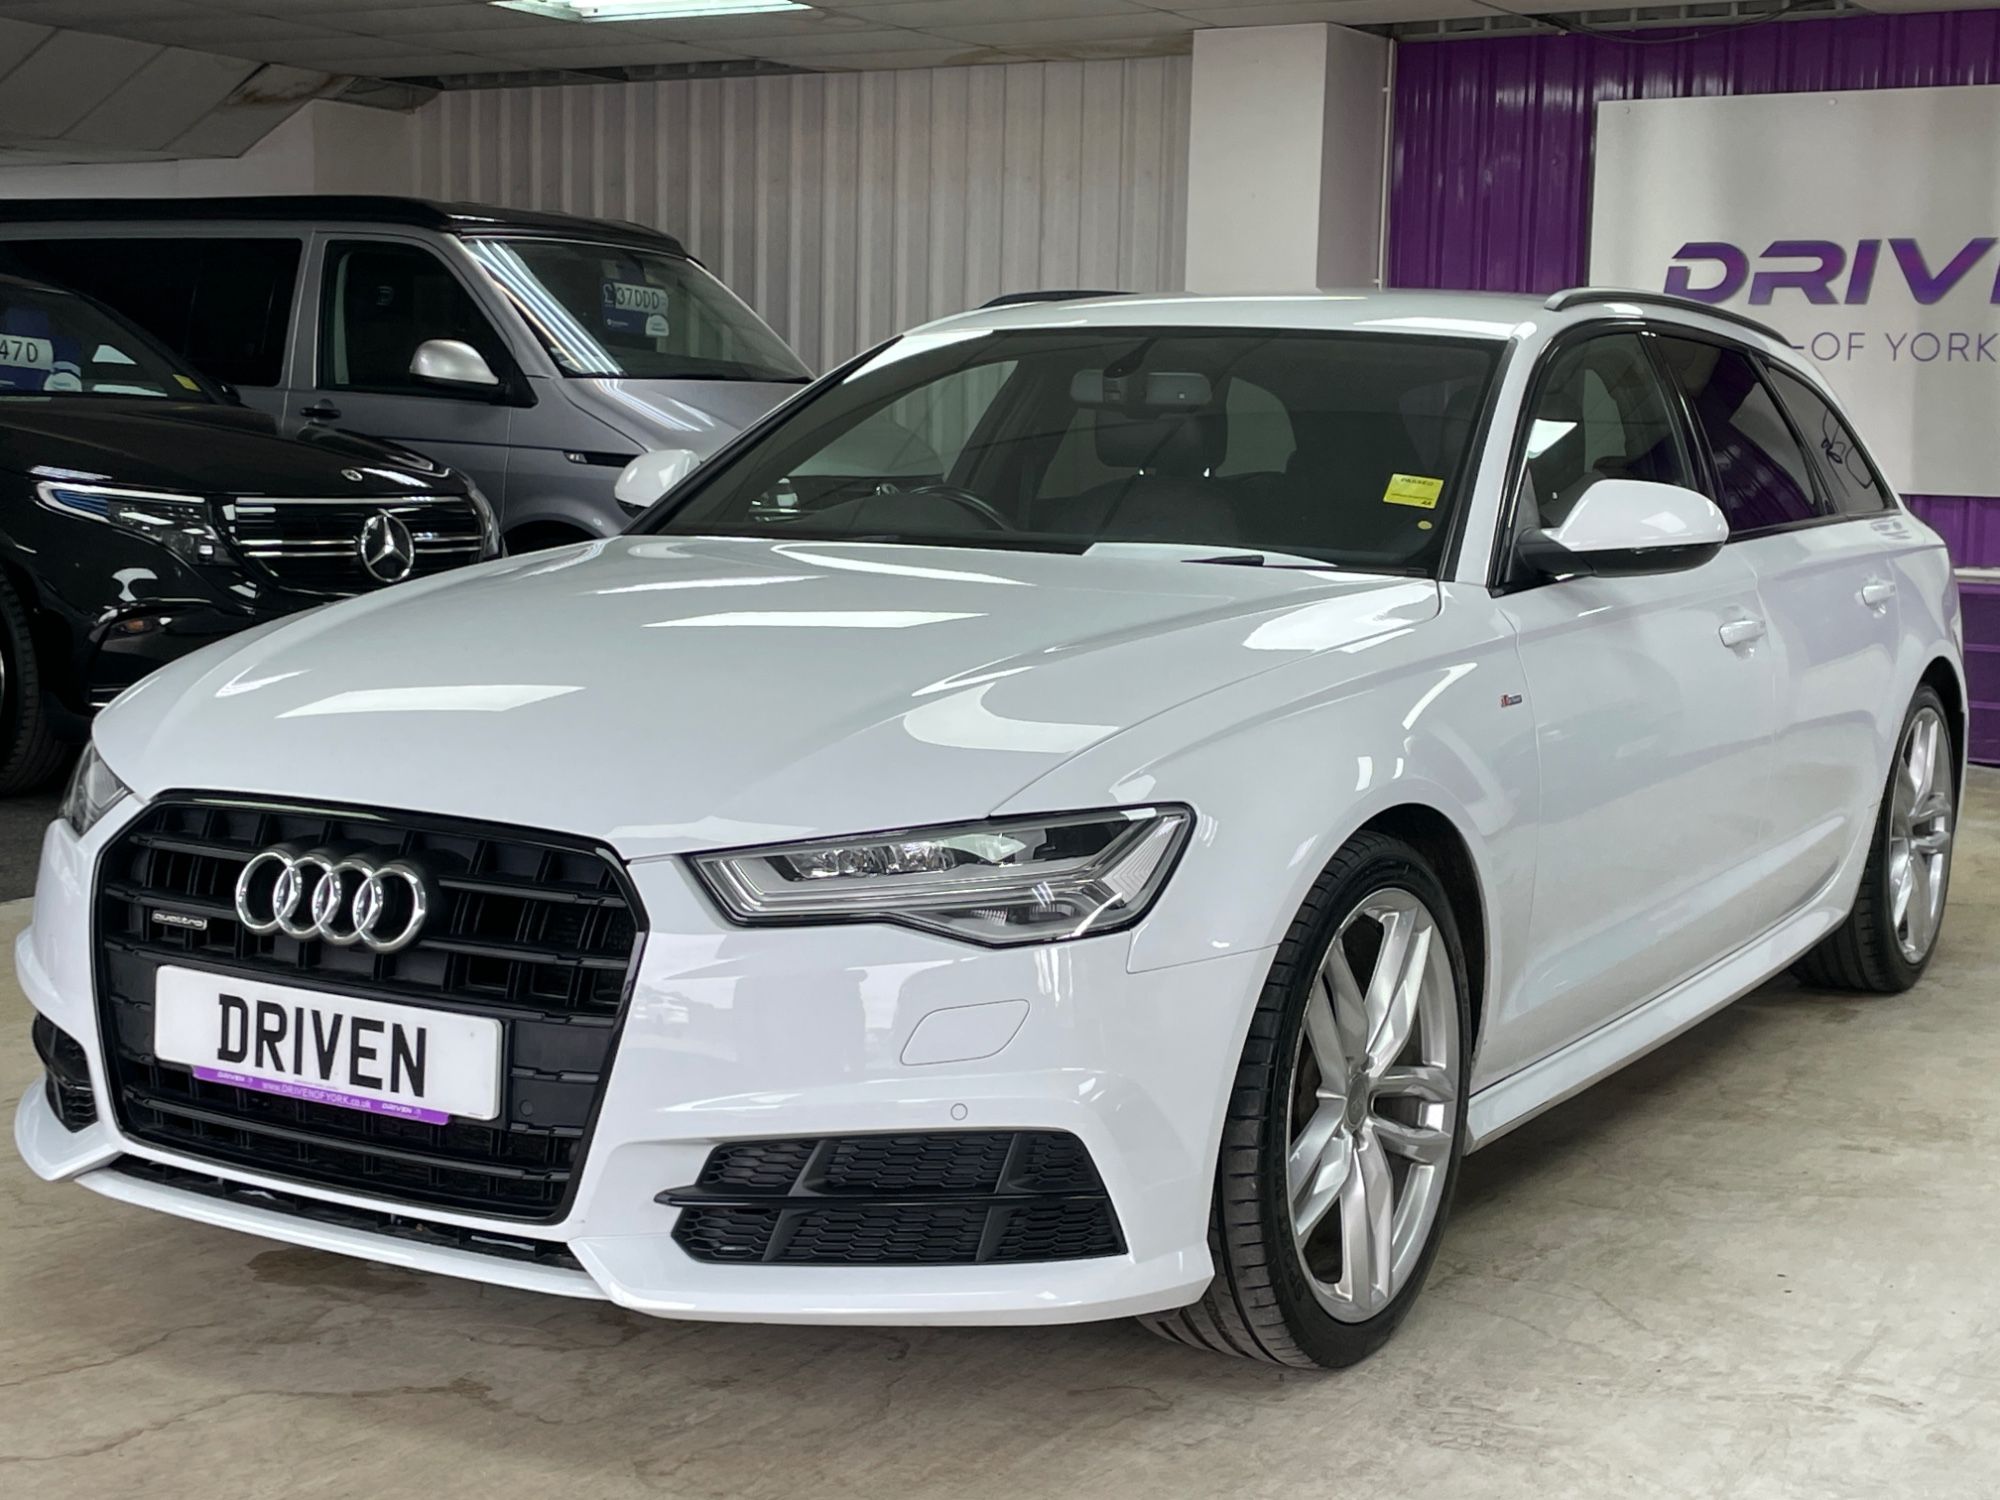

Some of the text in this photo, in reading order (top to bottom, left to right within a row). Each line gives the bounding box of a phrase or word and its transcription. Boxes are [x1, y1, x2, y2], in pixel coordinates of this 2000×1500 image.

[1811, 332, 1999, 362] OF YORK
[217, 993, 427, 1098] DRIVEN
[381, 1102, 412, 1115] DRIVEN
